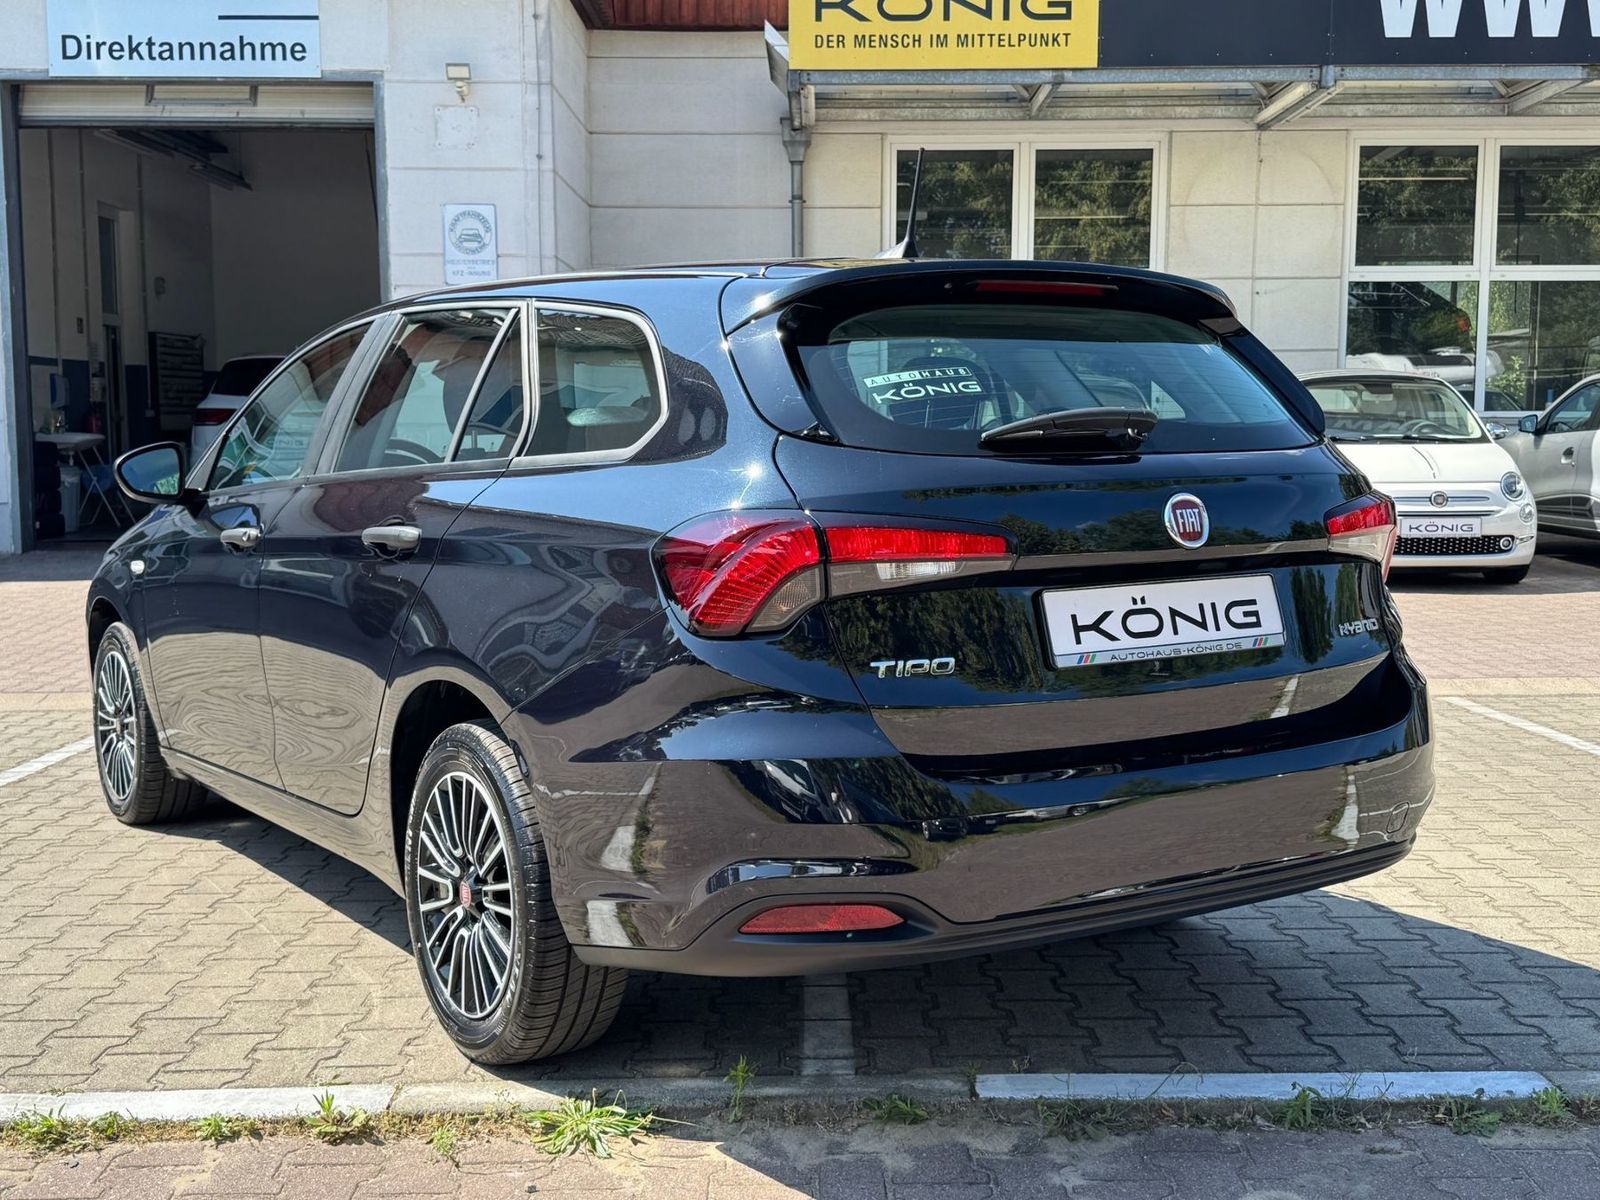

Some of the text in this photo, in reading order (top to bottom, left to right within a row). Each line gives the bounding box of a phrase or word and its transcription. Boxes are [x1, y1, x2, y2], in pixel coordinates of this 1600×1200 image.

[60, 34, 308, 62] Direktannahme
[814, 32, 1072, 49] DER MENSCH IM MITTELPUNKT
[869, 368, 968, 386] AUTOHAUS
[872, 381, 982, 404] KÖNIG
[1175, 508, 1201, 533] FIAT
[1408, 520, 1475, 533] KÖNIG
[1070, 595, 1262, 645] KÖNIG
[1110, 641, 1243, 662] AUTOHAUS-KÖNIG.DE
[869, 657, 956, 679] TIPO
